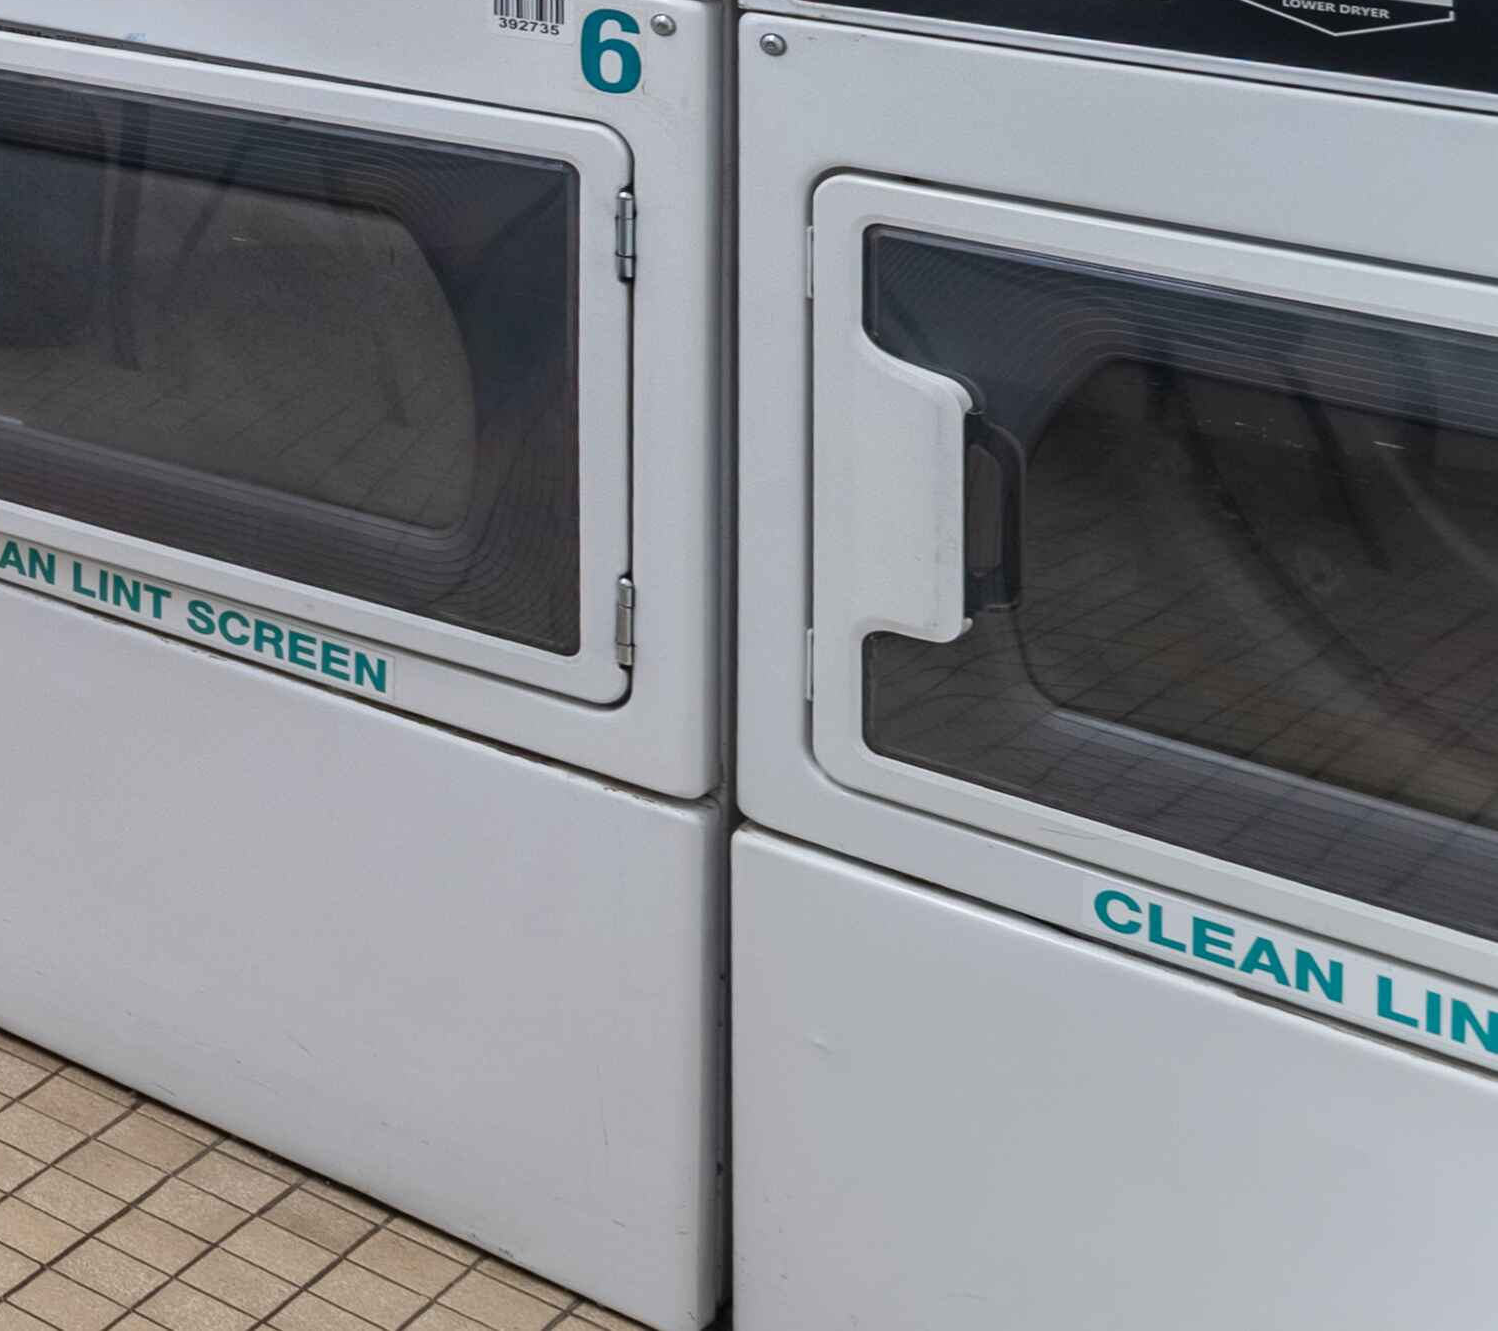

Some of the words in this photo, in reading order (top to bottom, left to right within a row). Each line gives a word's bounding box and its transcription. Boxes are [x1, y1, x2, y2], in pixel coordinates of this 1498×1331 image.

[498, 17, 560, 36] 392735
[580, 8, 642, 94] 6
[1339, 3, 1390, 20] DRYER
[72, 560, 172, 621] LINT
[186, 599, 386, 694] SCREEN
[1093, 889, 1344, 1004] CLEAN
